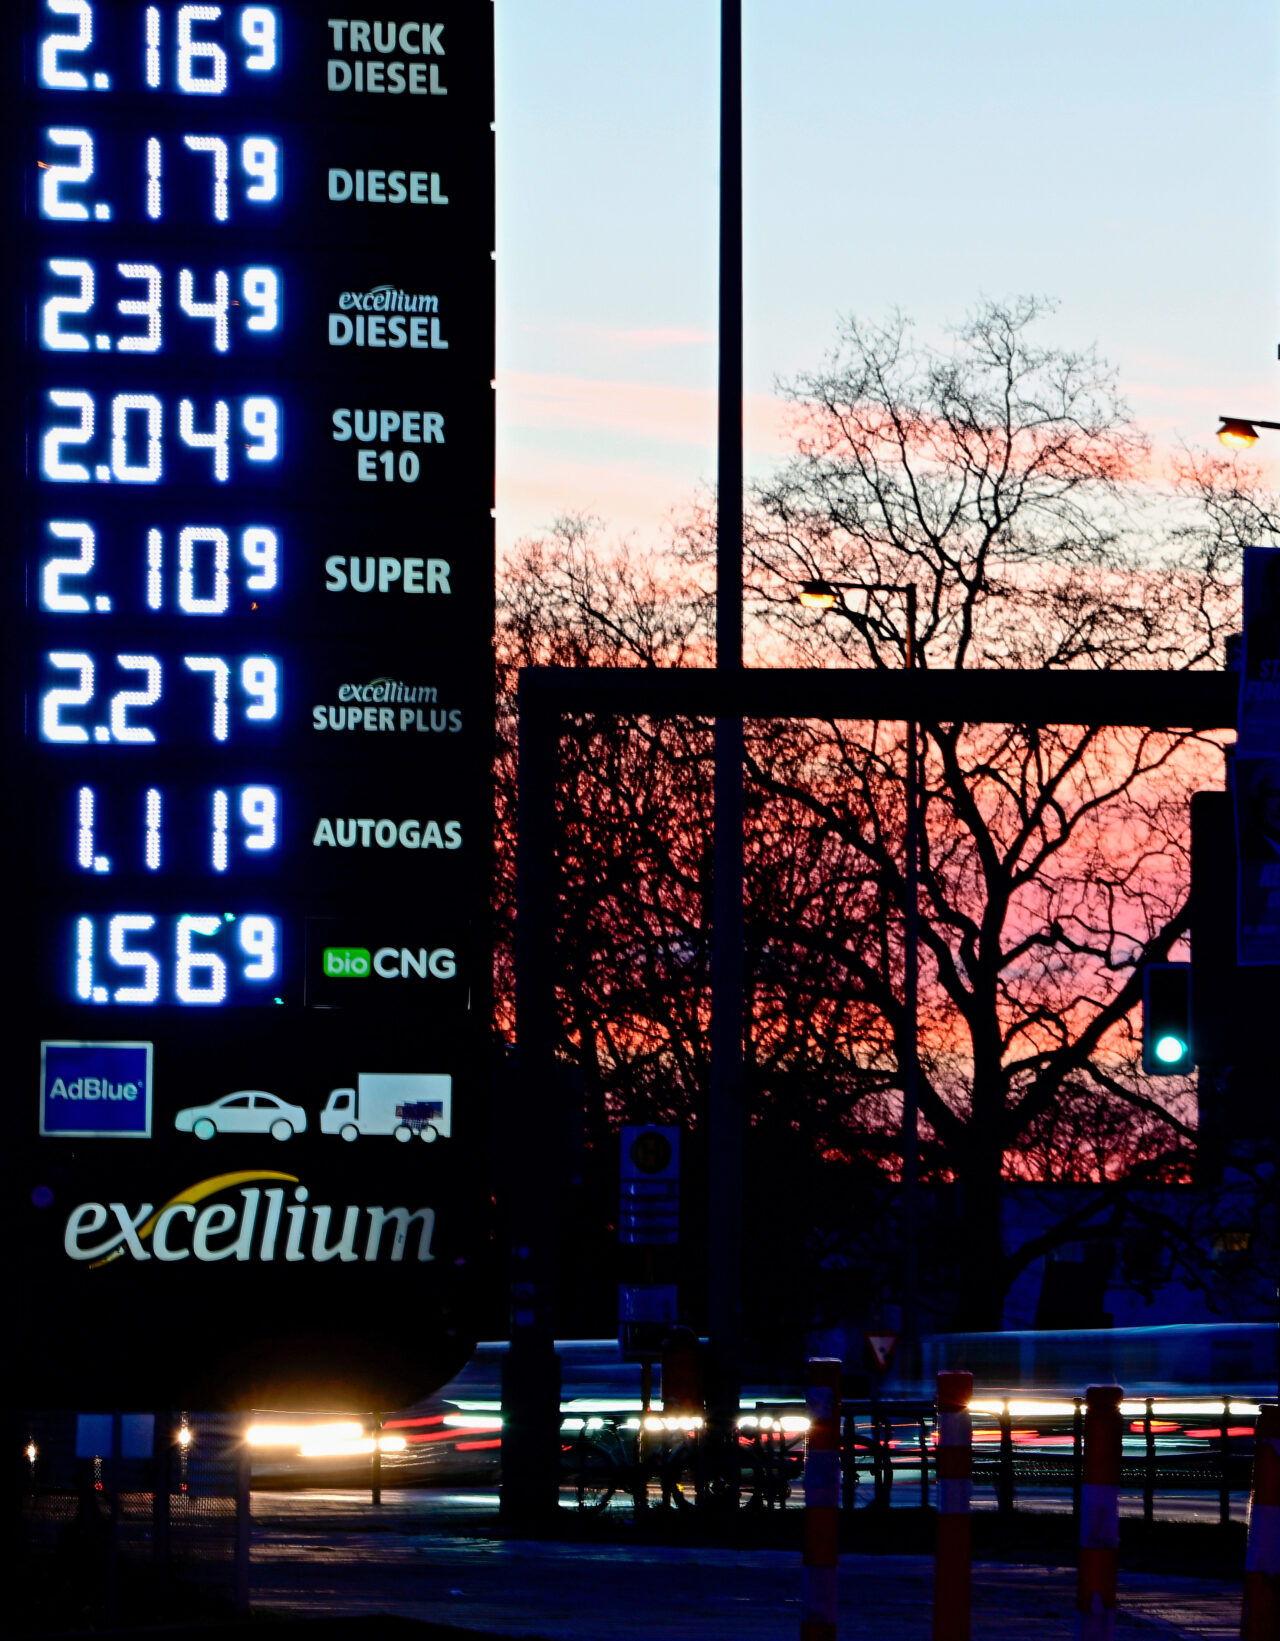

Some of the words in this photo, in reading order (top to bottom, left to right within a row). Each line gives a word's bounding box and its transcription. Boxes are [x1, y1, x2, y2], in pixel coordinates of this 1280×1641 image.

[327, 18, 447, 55] TRUCK
[327, 59, 449, 95] DIESEL
[40, 127, 279, 222] 2.179
[328, 168, 450, 205] DIESEL
[40, 257, 280, 353] 2.349
[338, 285, 440, 313] excellium
[328, 312, 450, 350] DIESEL
[40, 388, 280, 485] 2.049
[331, 408, 447, 444] SUPER
[357, 449, 421, 483] E10
[40, 520, 280, 616] 2.109
[325, 555, 453, 595] SUPER
[40, 651, 279, 744] 2.279
[338, 677, 439, 704] excellium
[312, 705, 395, 733] SUPER
[400, 707, 464, 733] PLUS
[312, 818, 464, 850] AUTOGAS
[64, 1185, 438, 1263] excellium
